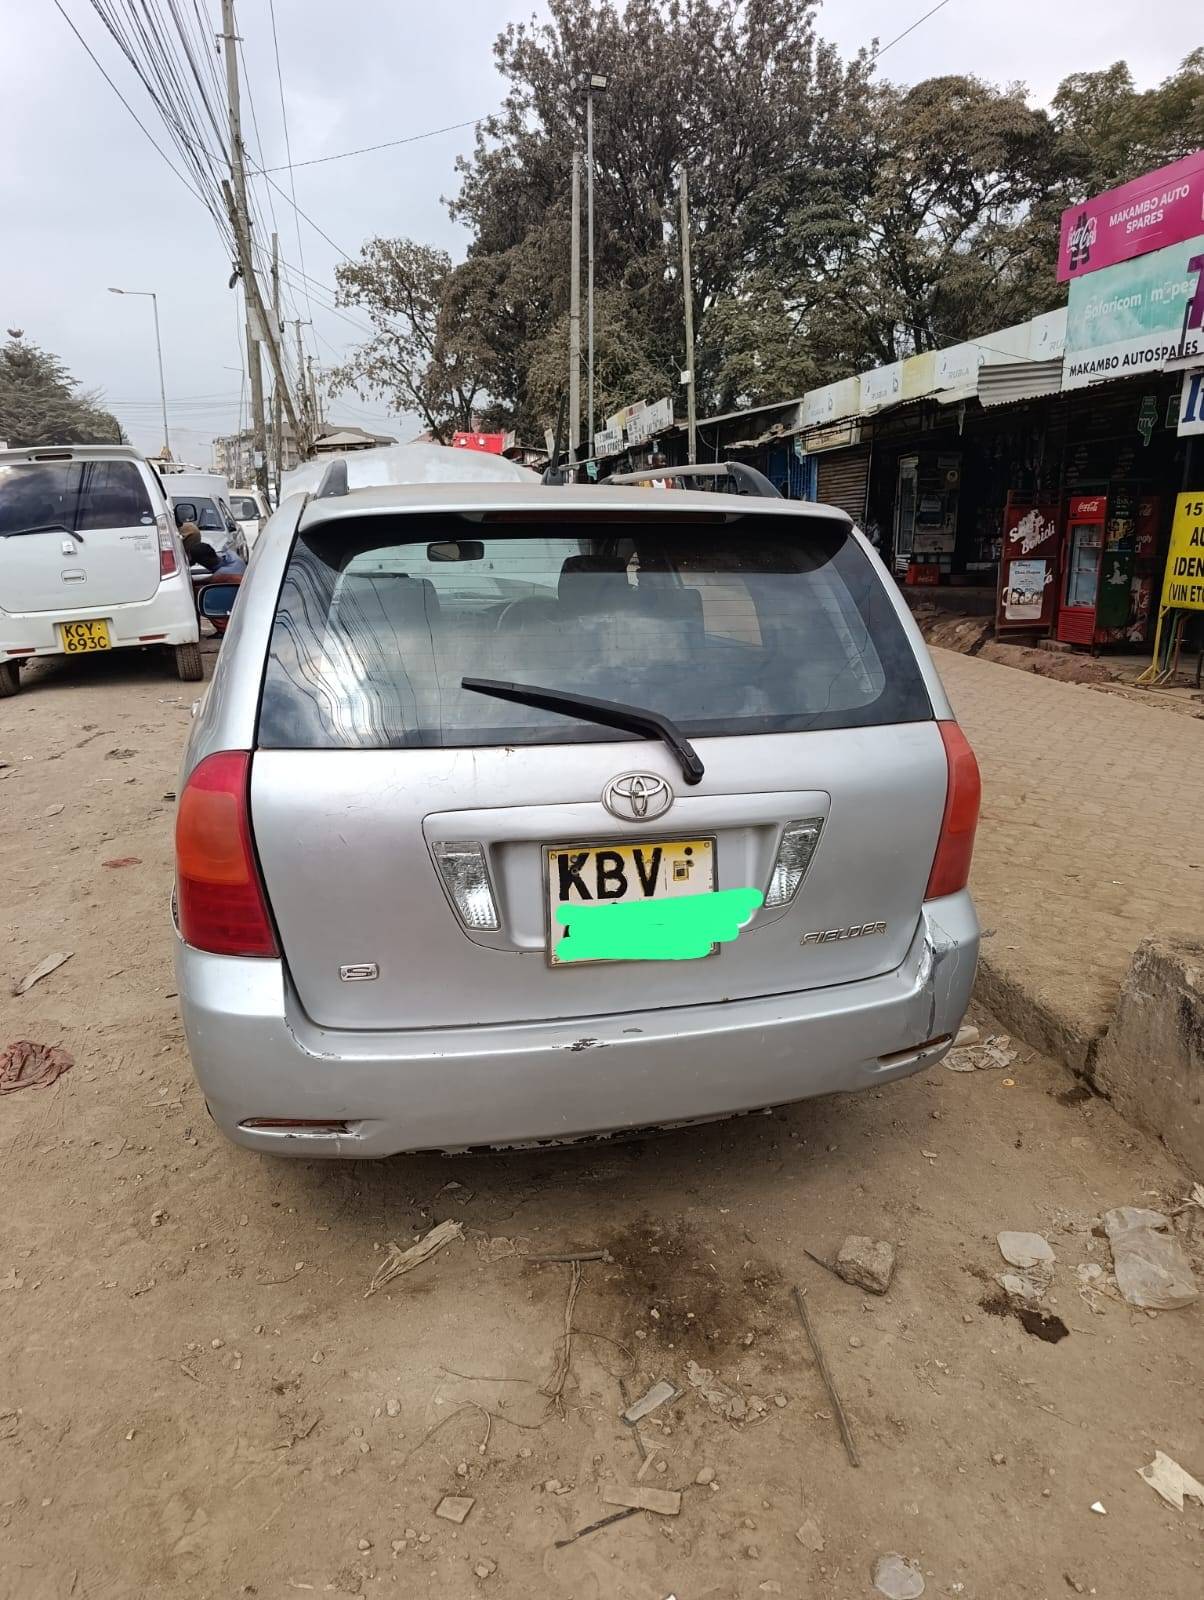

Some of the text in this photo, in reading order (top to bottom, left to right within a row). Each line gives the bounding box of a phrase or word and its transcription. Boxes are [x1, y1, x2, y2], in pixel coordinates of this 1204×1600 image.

[1109, 184, 1190, 227] MAKAMBO AUTO
[1126, 210, 1164, 234] SPARES
[1069, 340, 1198, 377] MAKAMBO AUTOSPAES
[1185, 502, 1203, 516] 15
[1169, 583, 1188, 601] (VIN
[64, 622, 94, 639] KCY
[67, 635, 107, 651] 693C
[557, 847, 663, 901] KBV
[800, 921, 886, 945] FIELDER
